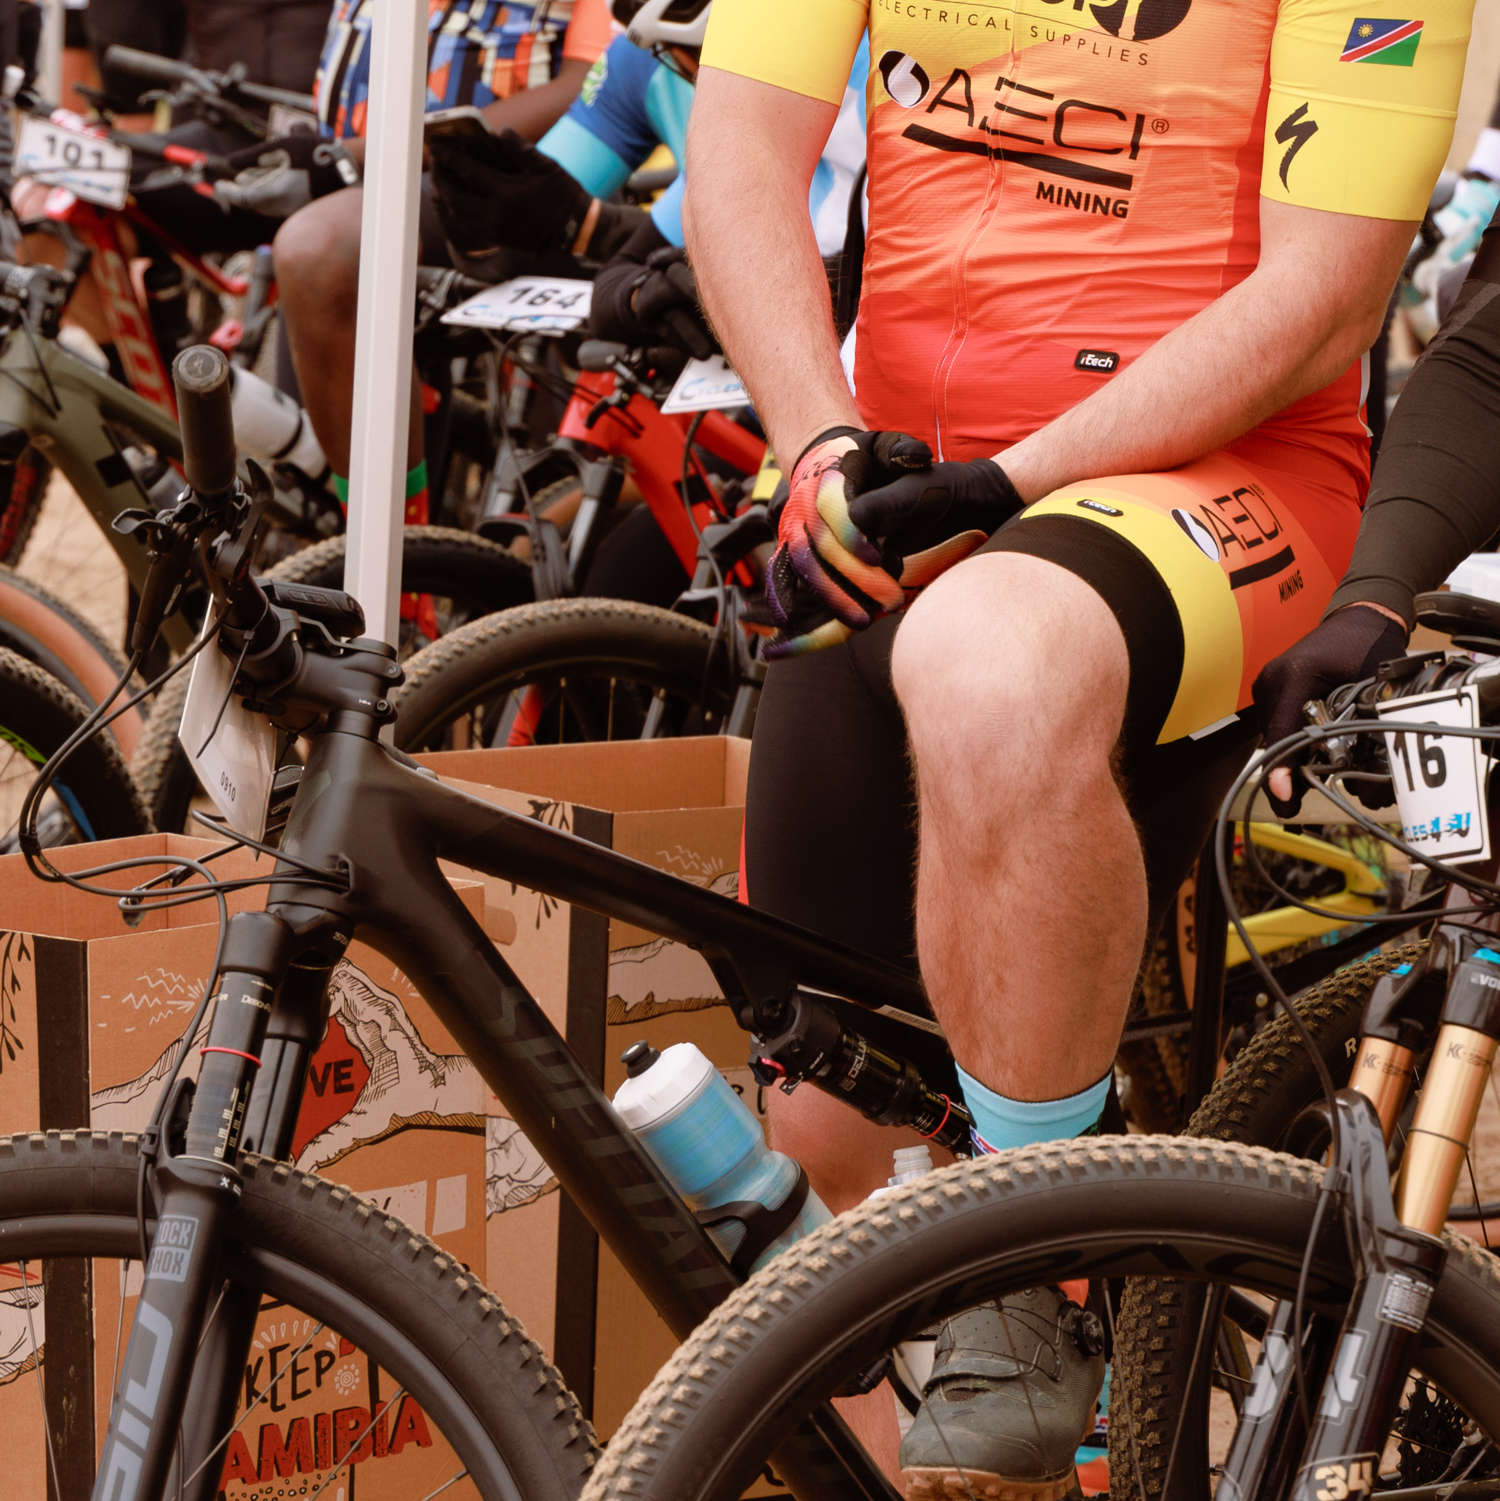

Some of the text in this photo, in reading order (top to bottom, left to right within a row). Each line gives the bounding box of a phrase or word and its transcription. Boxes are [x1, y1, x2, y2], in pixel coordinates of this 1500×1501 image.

[1028, 24, 1149, 68] SUPPLIES
[44, 134, 104, 169] 101
[1036, 180, 1130, 219] MINING
[1278, 569, 1304, 604] MINING
[1392, 720, 1448, 792] 16
[245, 1343, 336, 1413] KEEP
[218, 1395, 433, 1492] AMIBIA
